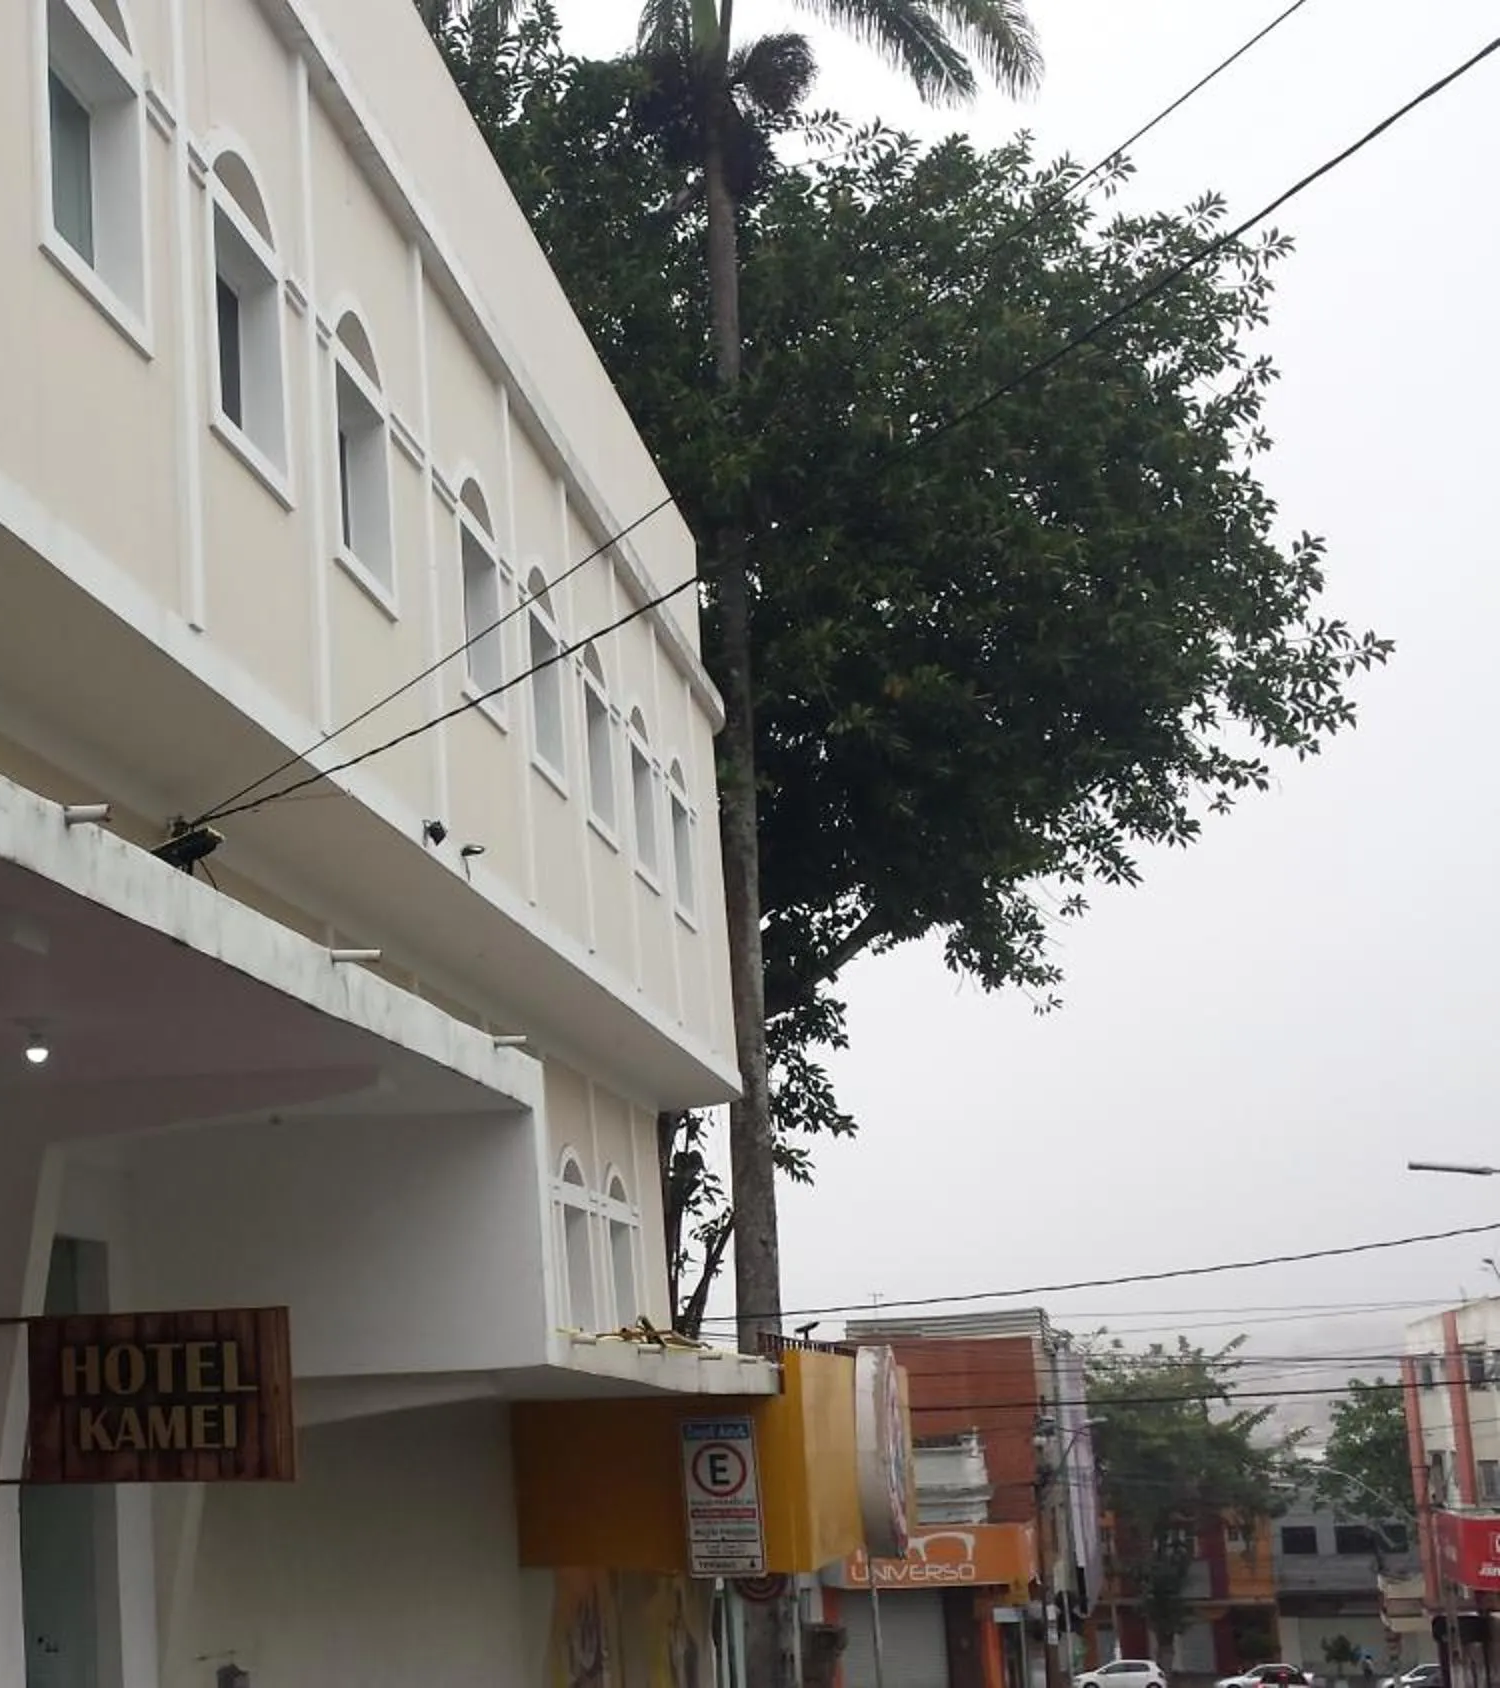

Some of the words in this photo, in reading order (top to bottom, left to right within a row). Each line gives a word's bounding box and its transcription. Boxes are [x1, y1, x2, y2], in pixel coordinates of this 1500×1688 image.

[62, 1341, 258, 1395] HOTEL
[80, 1404, 237, 1450] KAMEI
[709, 1453, 730, 1486] E
[851, 1563, 975, 1582] UNIVERSO
